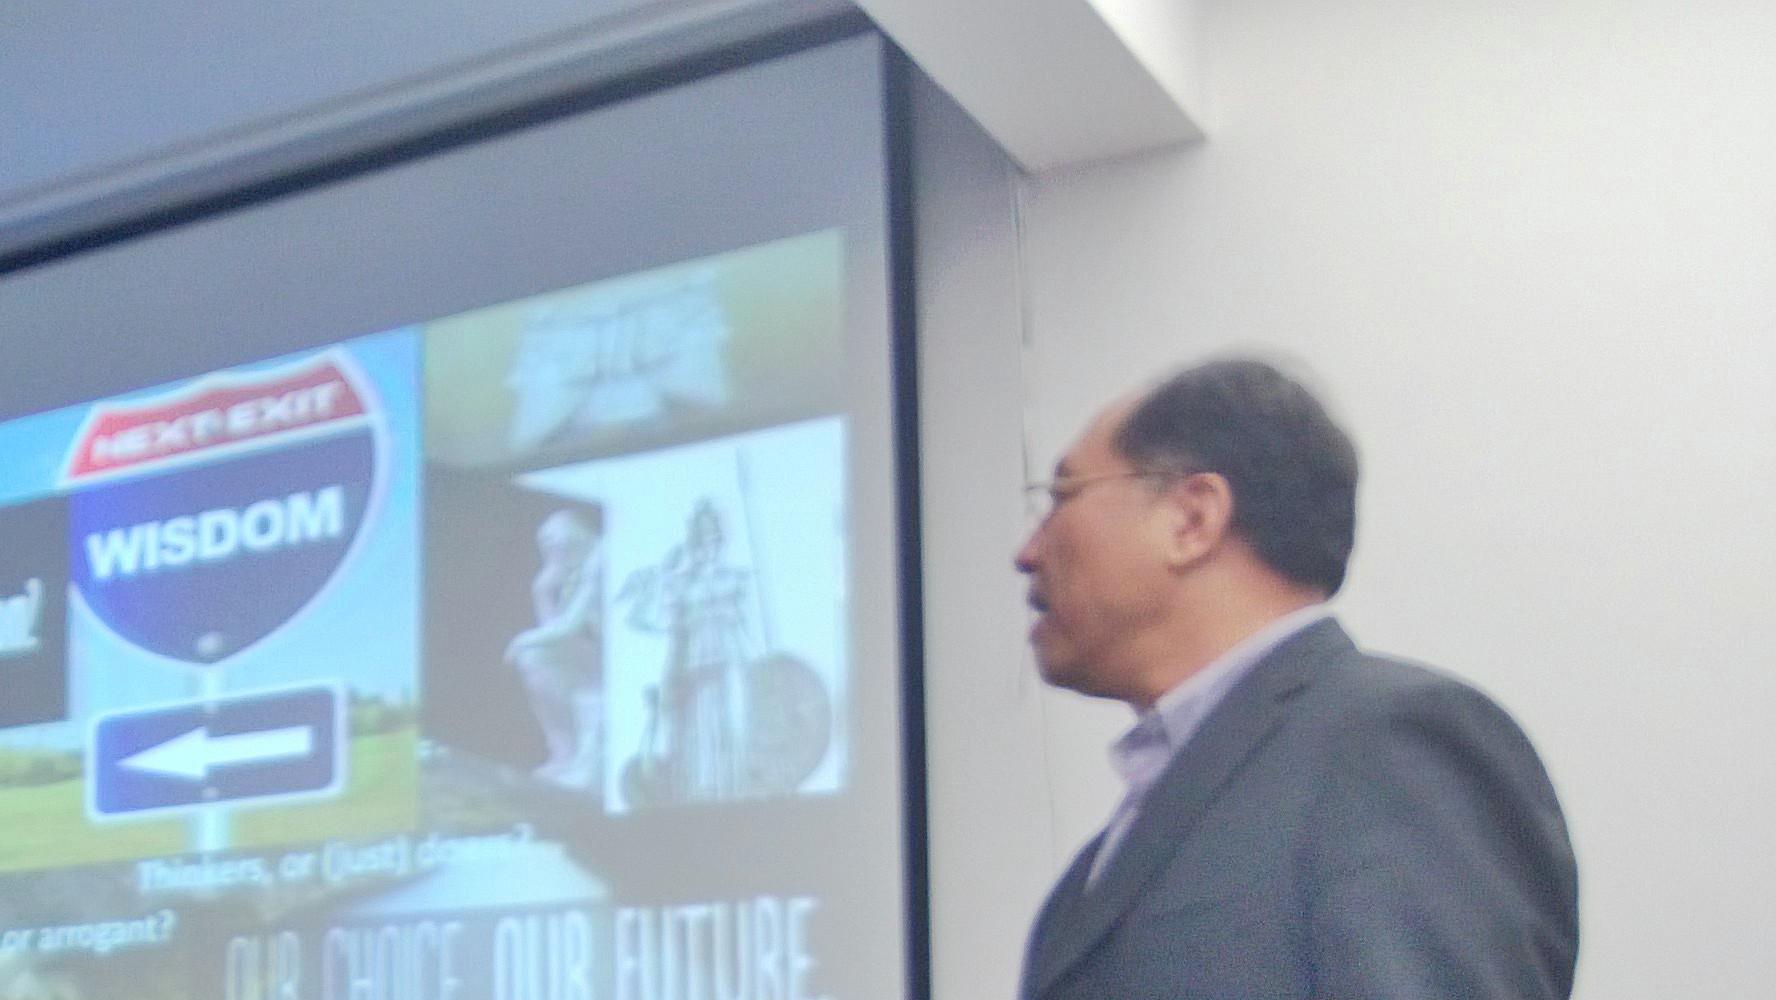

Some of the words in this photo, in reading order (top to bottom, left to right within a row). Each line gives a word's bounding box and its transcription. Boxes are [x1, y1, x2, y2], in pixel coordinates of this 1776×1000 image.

[92, 408, 222, 462] NEXT
[226, 379, 346, 436] EXIT
[85, 484, 345, 580] WISDOM
[277, 851, 317, 882] or
[38, 908, 176, 954] arrogant?
